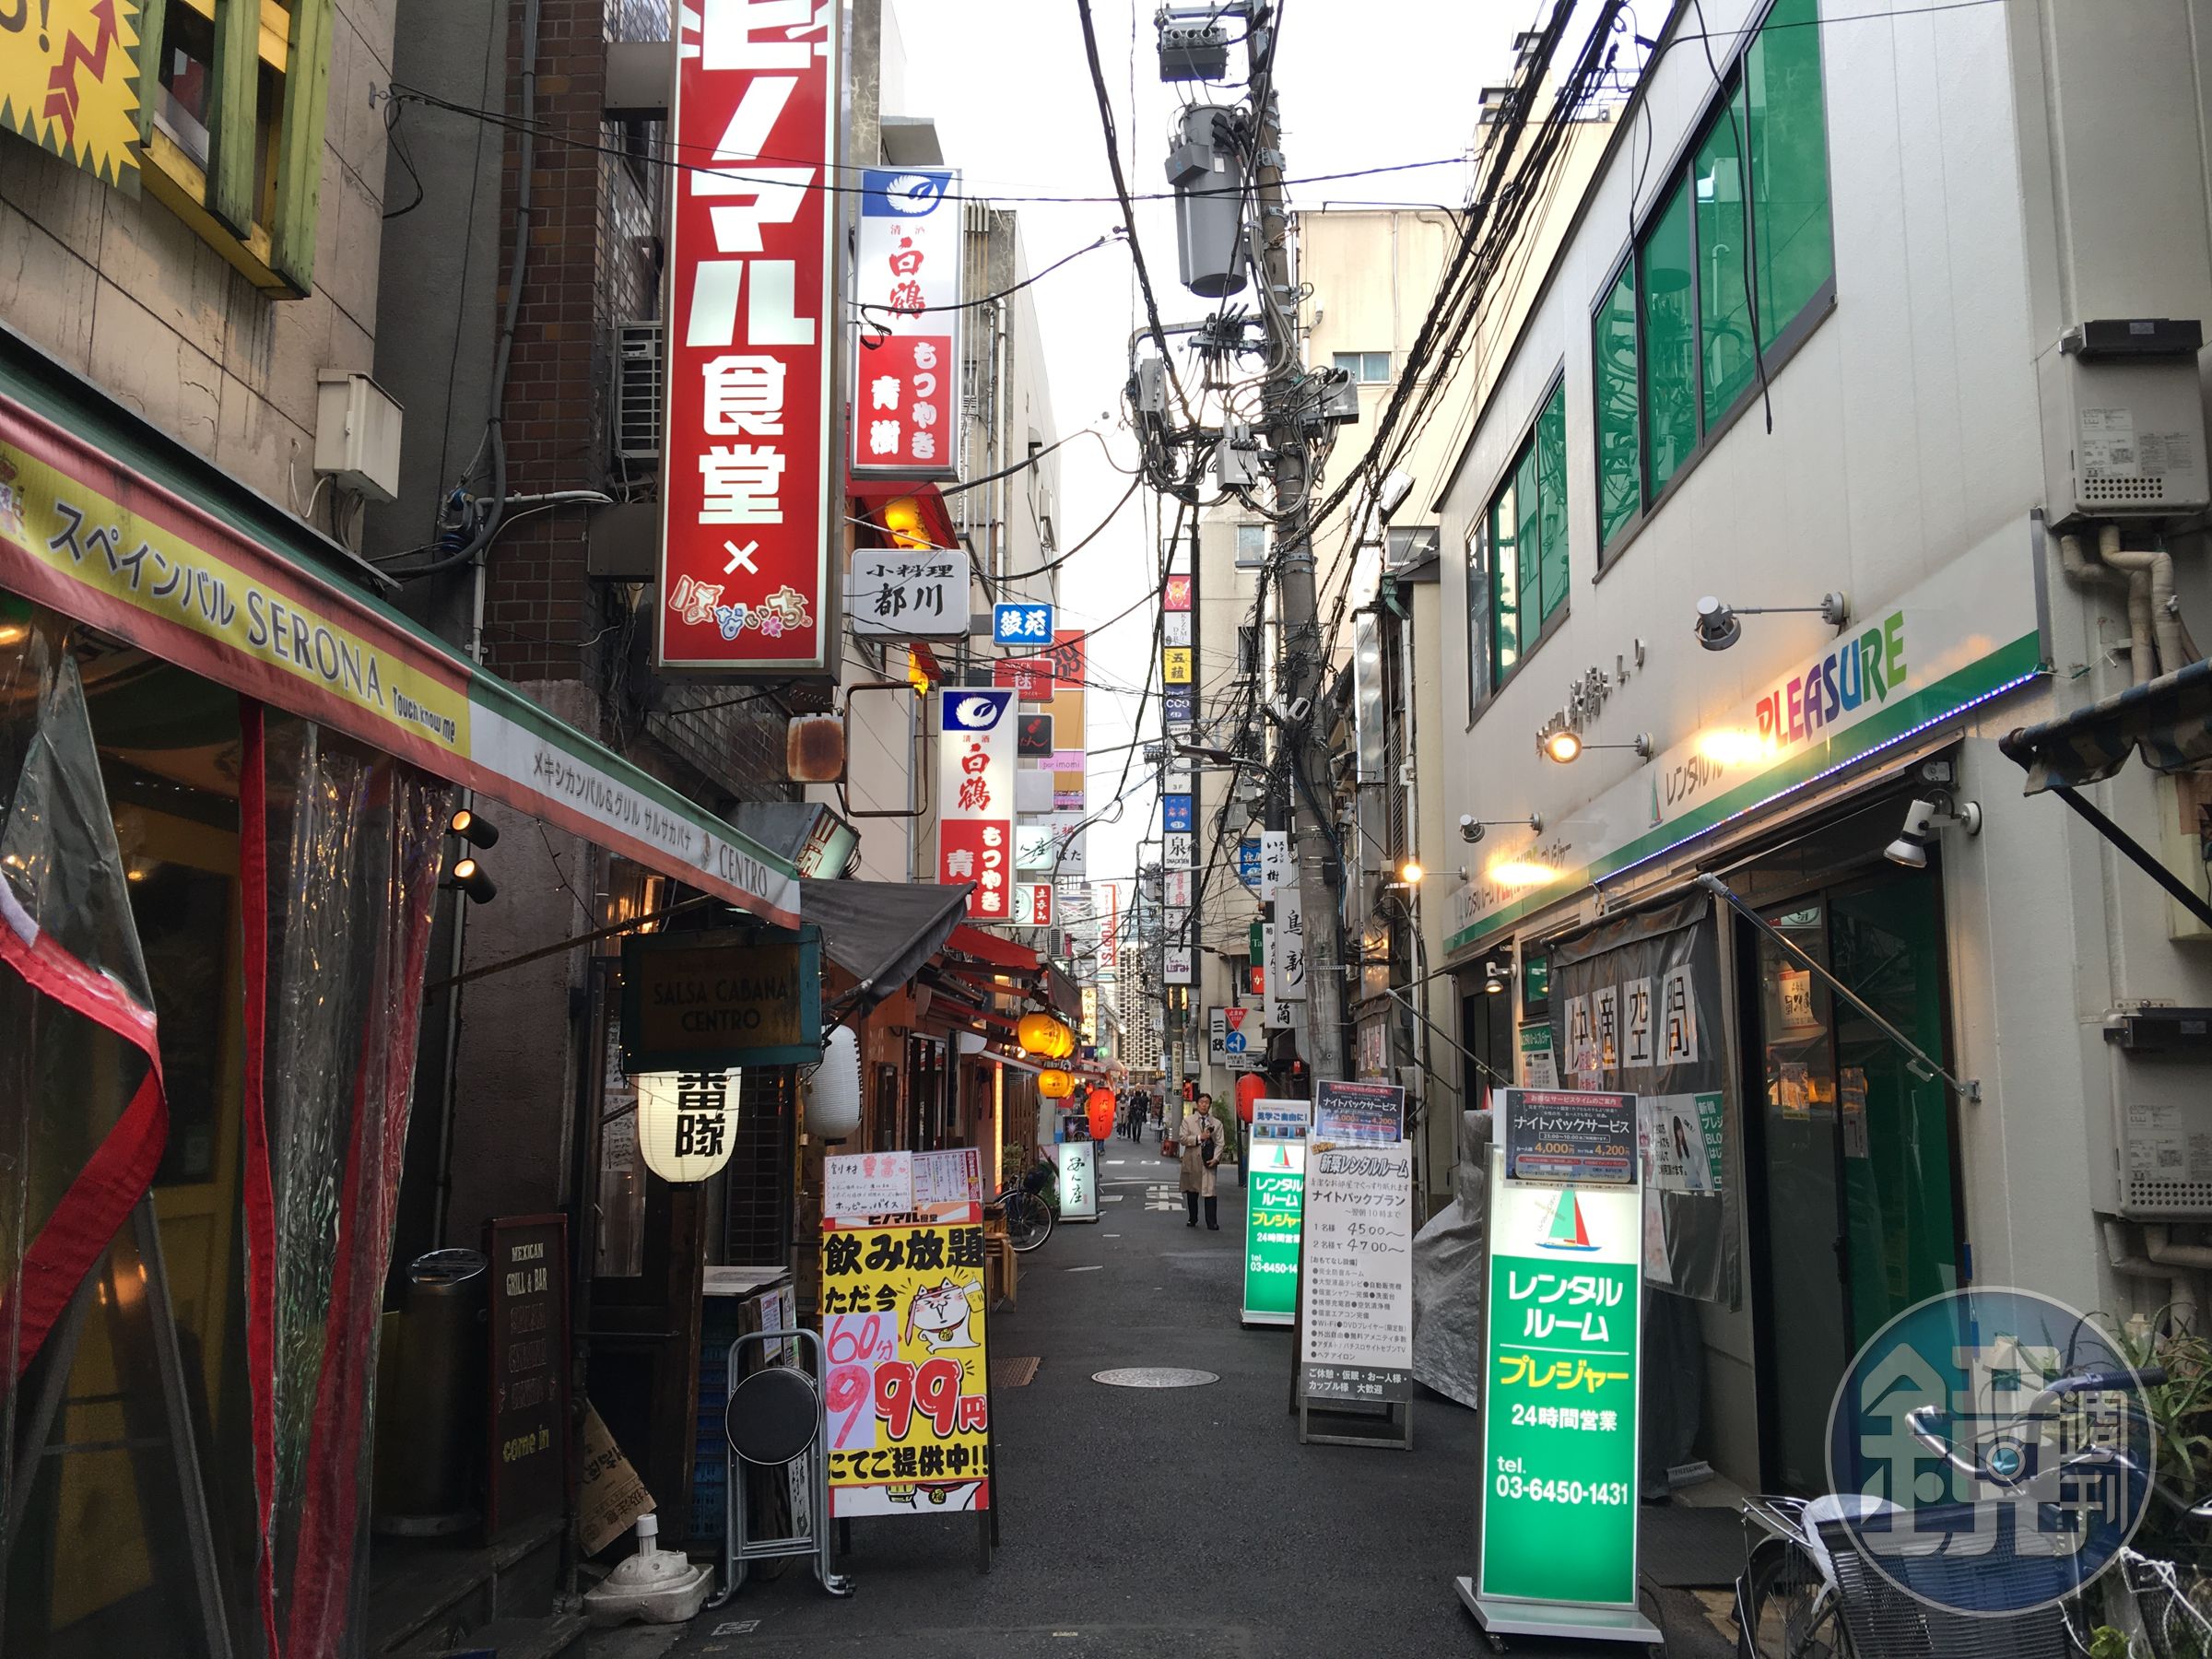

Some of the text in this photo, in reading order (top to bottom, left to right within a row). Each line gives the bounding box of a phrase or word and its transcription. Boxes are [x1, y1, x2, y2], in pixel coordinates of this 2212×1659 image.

[888, 236, 925, 320] 白鶴
[912, 342, 937, 459] もつやき
[866, 564, 955, 579] 小料理
[50, 502, 384, 706] スペインバル SERONA
[874, 582, 944, 617] 都川
[1756, 610, 1907, 748] PLEASURE
[393, 687, 456, 743] Touch know me
[958, 744, 991, 811] 白鶴
[1170, 837, 1186, 856] 泉
[720, 843, 768, 898] CENTRO
[982, 826, 1003, 912] もつやき
[1036, 888, 1048, 921] 立呑み
[653, 976, 789, 1006] SALSA CABANA
[681, 1007, 762, 1033] CENTRO
[1324, 1097, 1397, 1112] ナイトパックサービス
[1531, 1094, 1617, 1105] お得なサービスタイムのご案内
[1513, 1115, 1630, 1134] ナイトパックサービス
[1320, 1153, 1409, 1179] 新築レンタルルーム
[1256, 1177, 1304, 1193] レンタル
[1262, 1193, 1299, 1206] ルーム
[1253, 1212, 1301, 1229] プレジャー
[512, 1242, 544, 1263] MEXICAN
[823, 1230, 984, 1277] 飲み放題
[506, 1266, 548, 1297] GRILL & BAR
[1508, 1270, 1624, 1306] レンタル
[825, 1283, 898, 1314] ただ今
[827, 1314, 894, 1365] 60分
[1524, 1310, 1609, 1343] ルーム
[1309, 1381, 1382, 1394] カップル様 大歓迎
[1499, 1356, 1630, 1394] プレジャー
[1512, 1404, 1618, 1432] 24時間営業
[502, 1423, 550, 1464] come in
[827, 1443, 990, 1479] にてご提供中!!
[1497, 1456, 1526, 1475] tel.
[1496, 1475, 1629, 1506] 03-6450-1431
